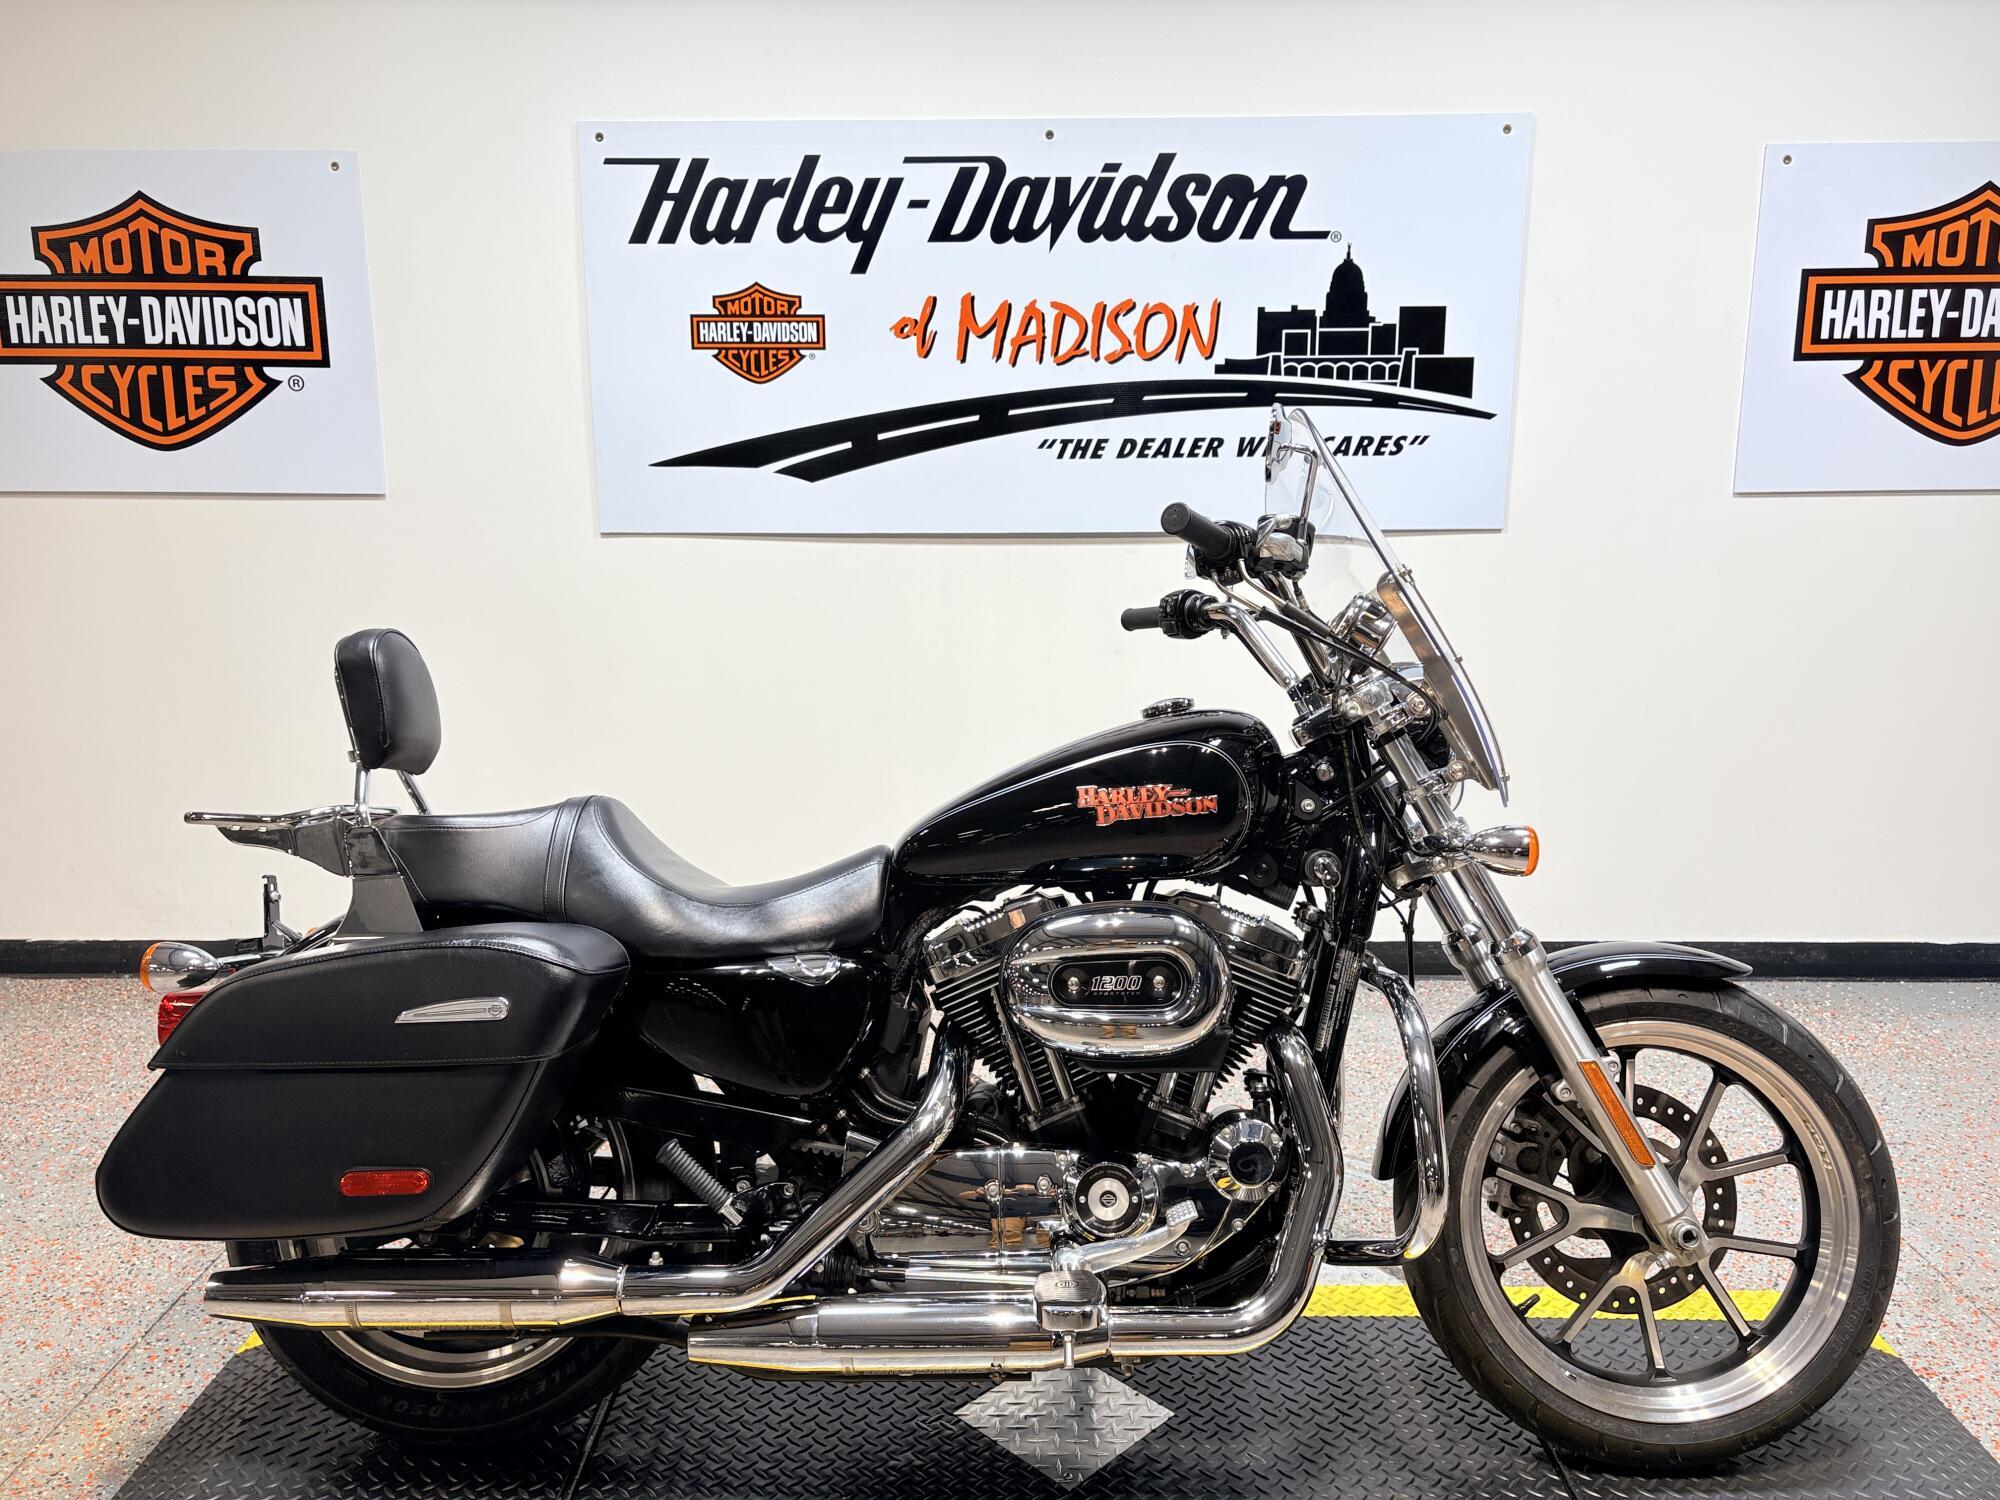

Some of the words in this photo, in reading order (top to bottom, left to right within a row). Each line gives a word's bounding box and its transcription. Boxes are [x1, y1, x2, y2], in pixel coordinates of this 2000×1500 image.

[603, 154, 1331, 274] Harley-Davidson
[69, 216, 226, 276] MOTOR
[1902, 207, 2000, 267] MOT
[5, 295, 306, 347] HARLEY-DAVIDSON
[727, 291, 789, 316] MOTOR
[699, 321, 818, 343] HARLEY-DAVIDSON
[956, 292, 1222, 368] MADISON
[728, 350, 790, 377] CYCLES
[81, 364, 237, 432] CYCLES
[1116, 437, 1225, 460] DEALER
[1096, 795, 1218, 826] DAVIDSON
[1090, 975, 1142, 991] 1200
